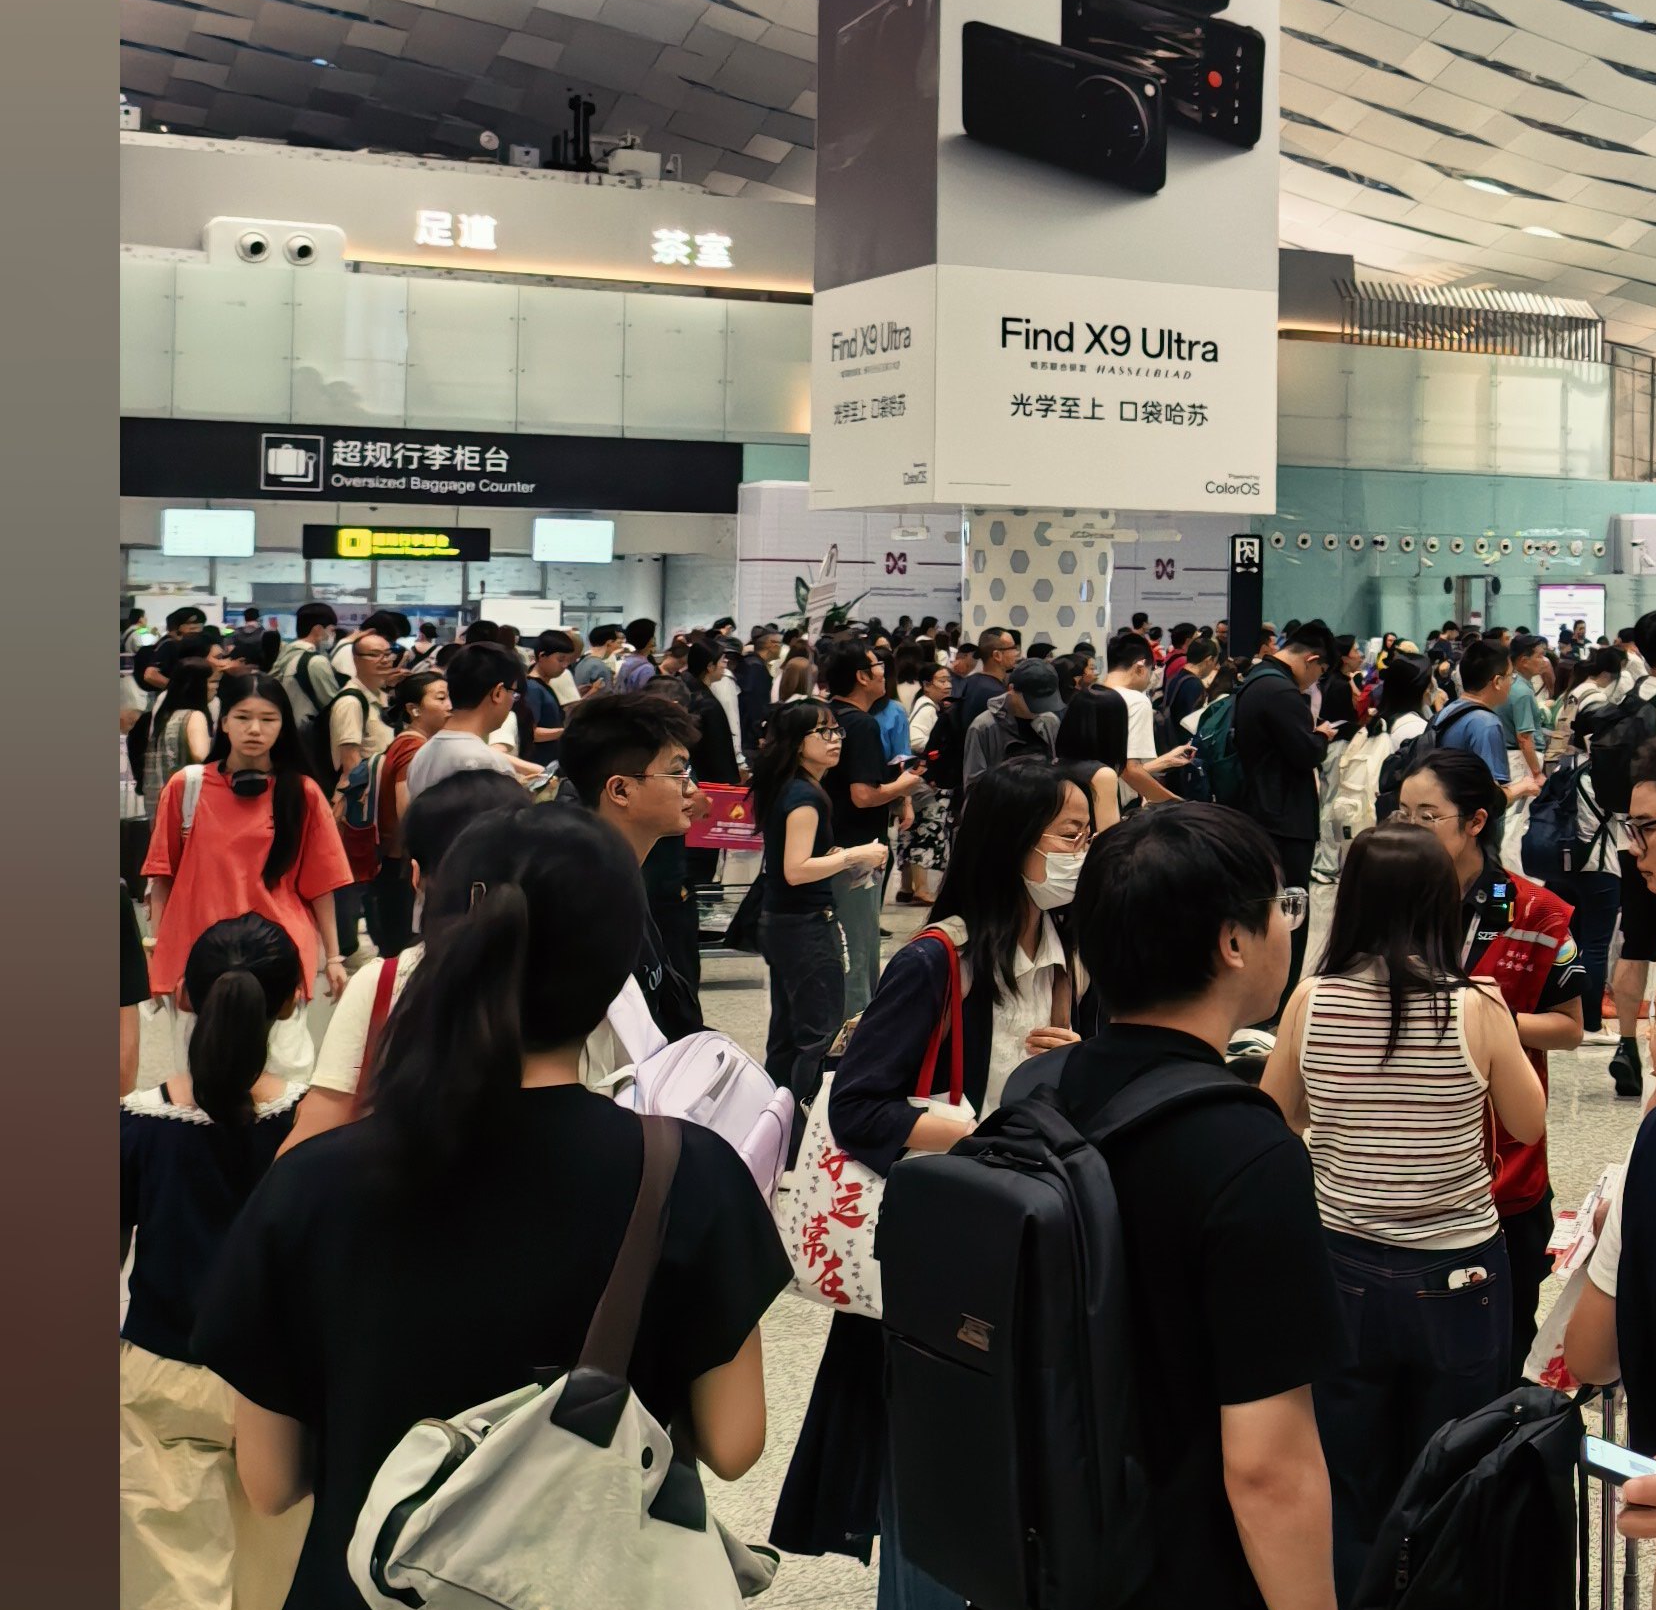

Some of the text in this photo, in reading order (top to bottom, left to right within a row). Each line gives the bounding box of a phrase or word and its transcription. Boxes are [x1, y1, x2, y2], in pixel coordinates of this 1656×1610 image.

[414, 209, 497, 250] 足道
[651, 228, 733, 268] 茶室
[831, 320, 911, 362] Find X9 Ultra
[1001, 317, 1219, 363] Find X9 Ultra
[1096, 365, 1192, 380] HASSELBLAD
[1010, 393, 1209, 427] 光学至上 口袋哈苏
[332, 439, 510, 473] 超规行李柜台
[331, 473, 536, 494] Oversized Baggage Counter
[1205, 481, 1260, 495] ColorOS
